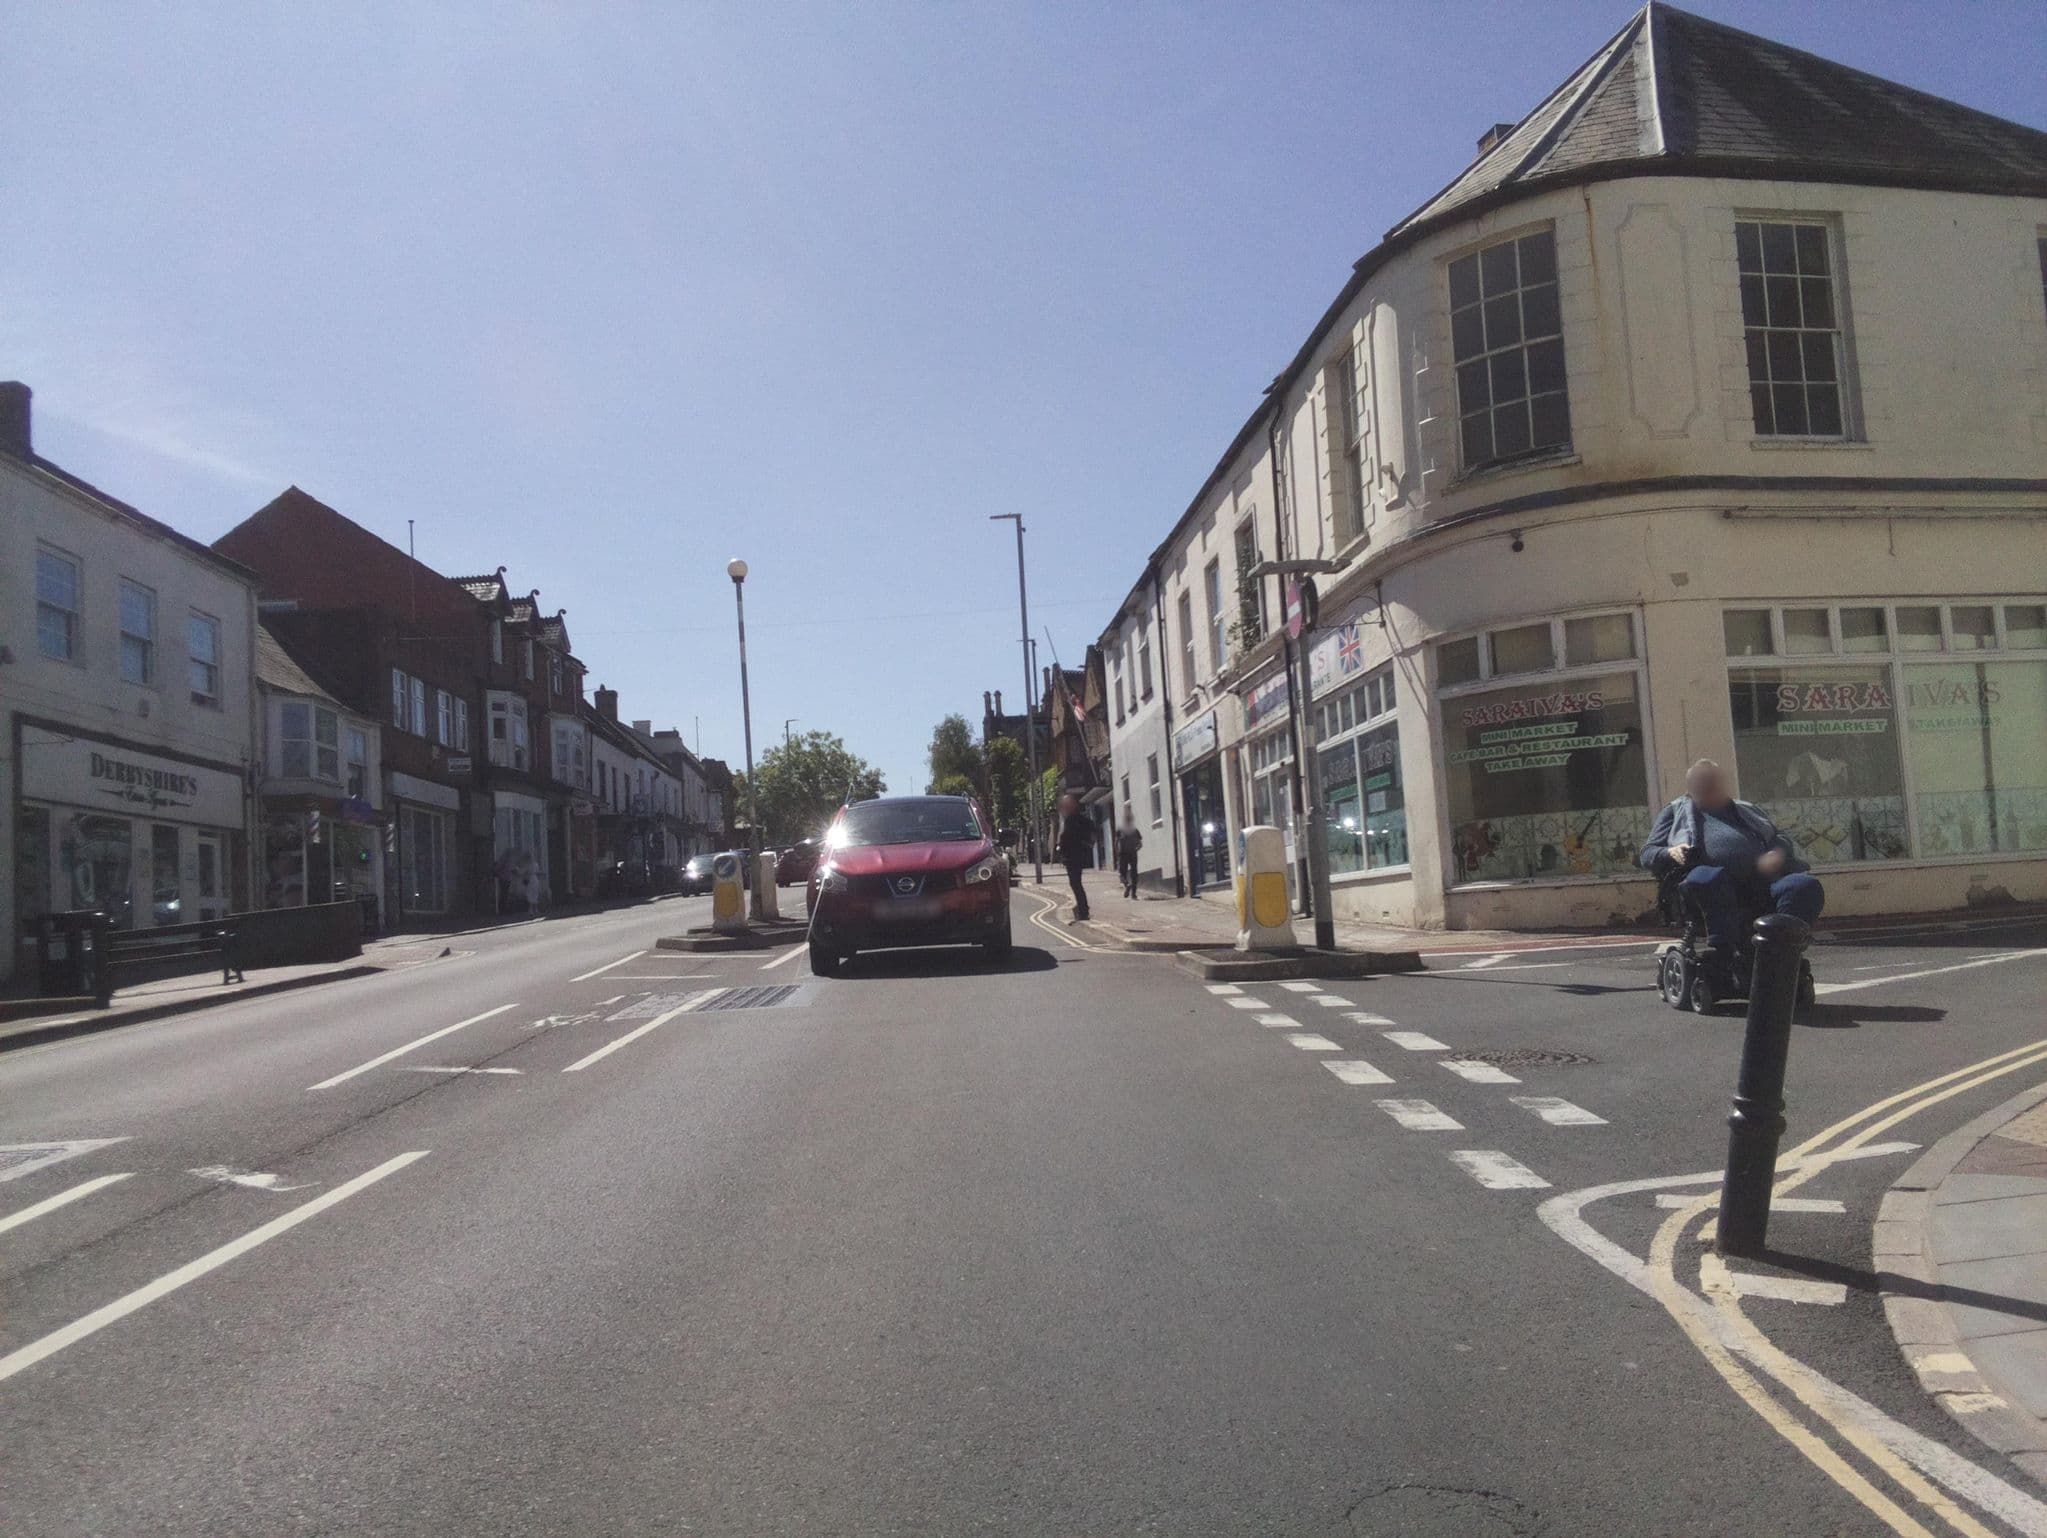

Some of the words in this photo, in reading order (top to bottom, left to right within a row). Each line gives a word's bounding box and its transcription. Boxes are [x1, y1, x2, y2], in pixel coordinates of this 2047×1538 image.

[1463, 692, 1604, 727] SARAIVA'S
[1481, 731, 1507, 745] MINI
[1510, 723, 1577, 741] MARKET
[1781, 720, 1814, 735] MINI
[1521, 734, 1627, 753] RESTAURANT
[1486, 759, 1521, 772] TAKE
[1522, 754, 1571, 769] AWAY
